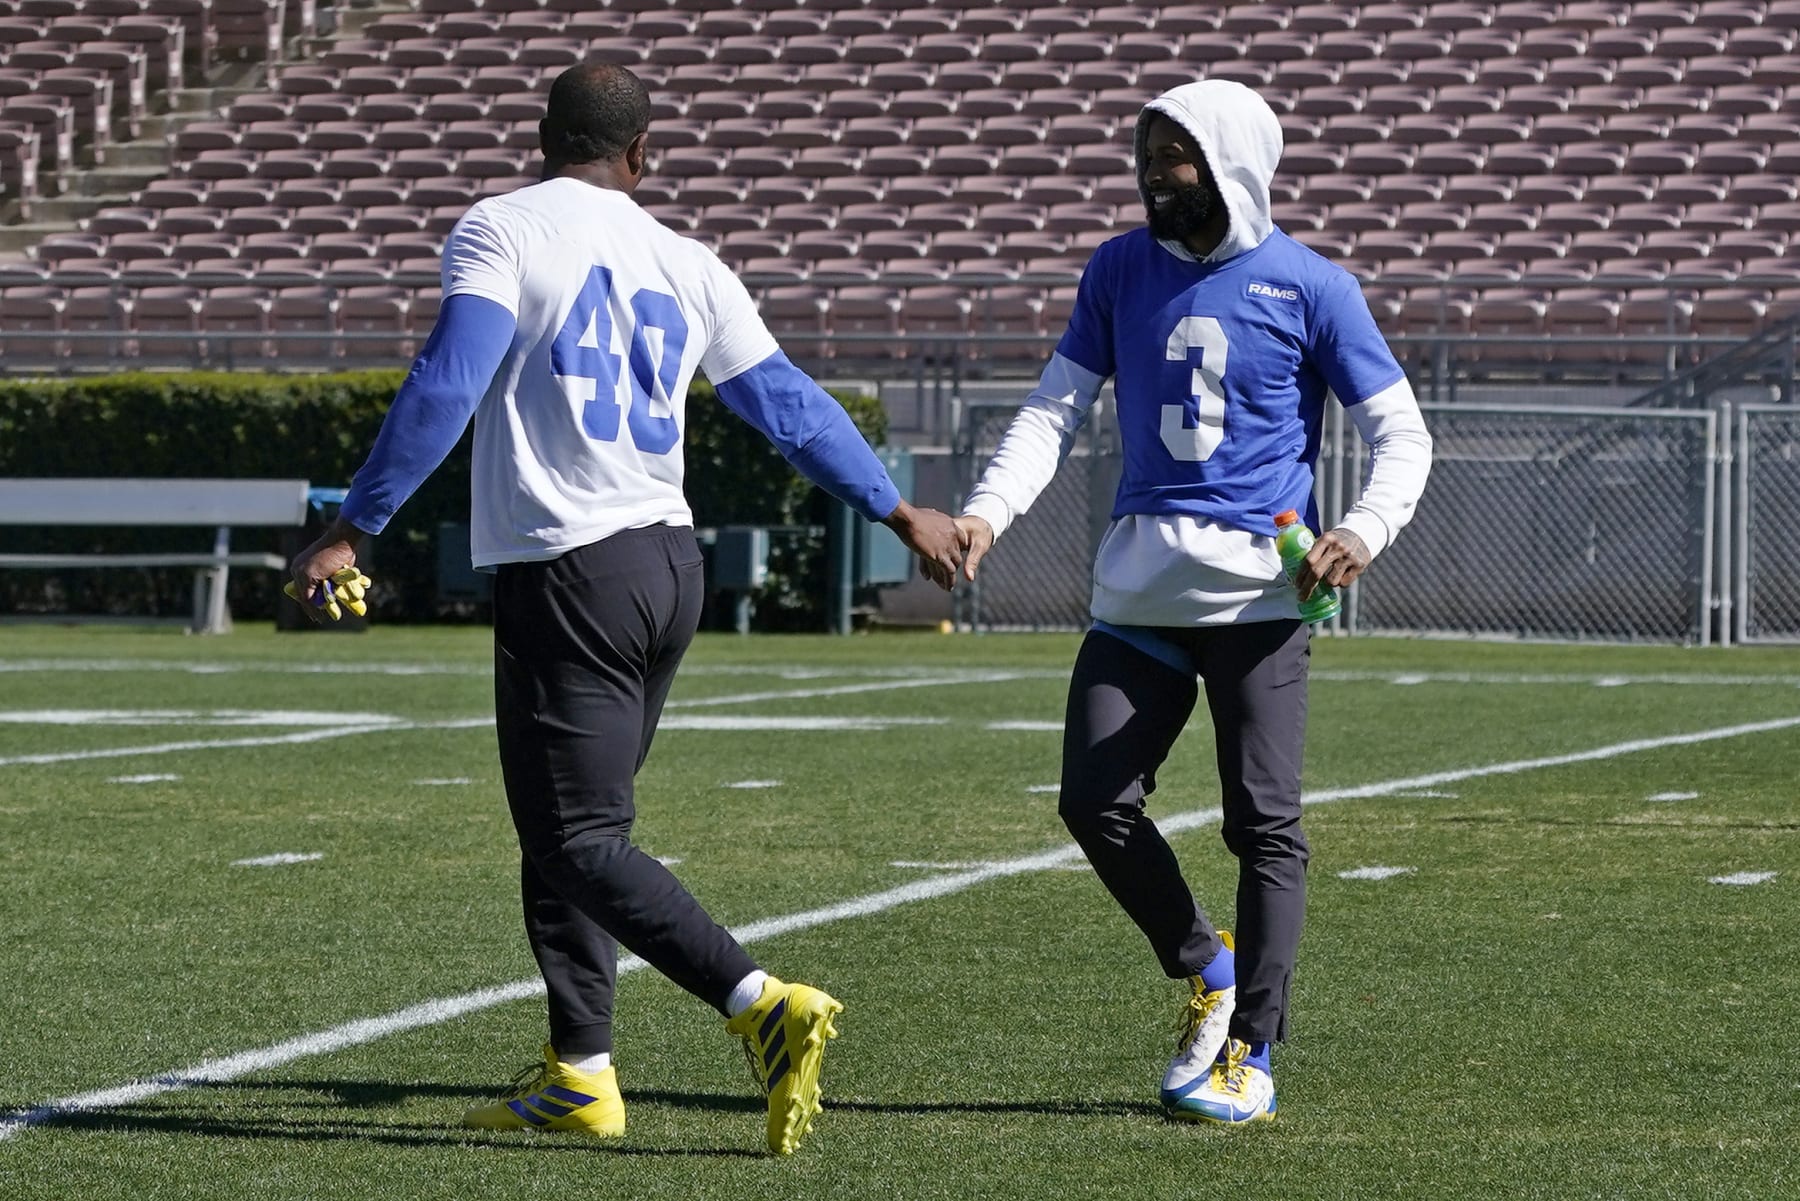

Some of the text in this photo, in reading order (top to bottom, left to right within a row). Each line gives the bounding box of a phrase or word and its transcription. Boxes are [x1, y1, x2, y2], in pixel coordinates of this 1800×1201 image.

[551, 264, 688, 455] 40
[1248, 283, 1298, 301] RAMS
[1160, 316, 1229, 462] 3
